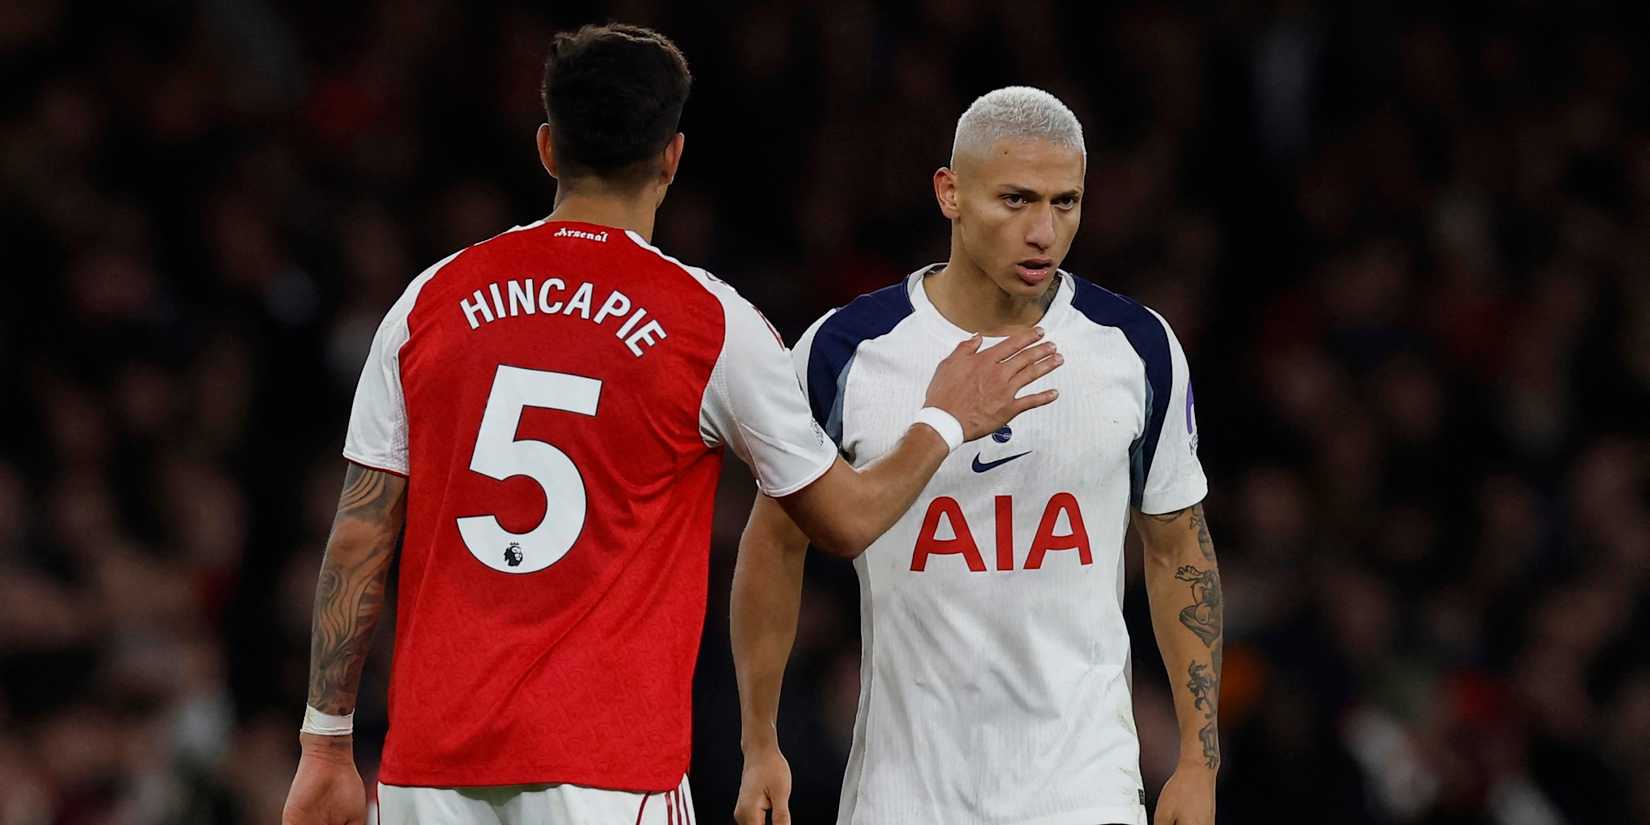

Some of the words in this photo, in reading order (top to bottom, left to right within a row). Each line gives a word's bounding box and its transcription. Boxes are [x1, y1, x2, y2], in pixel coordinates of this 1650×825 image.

[554, 227, 609, 242] Arsenal
[459, 277, 668, 358] HINCAPIE
[456, 364, 603, 574] 5
[910, 492, 1094, 572] AIA
